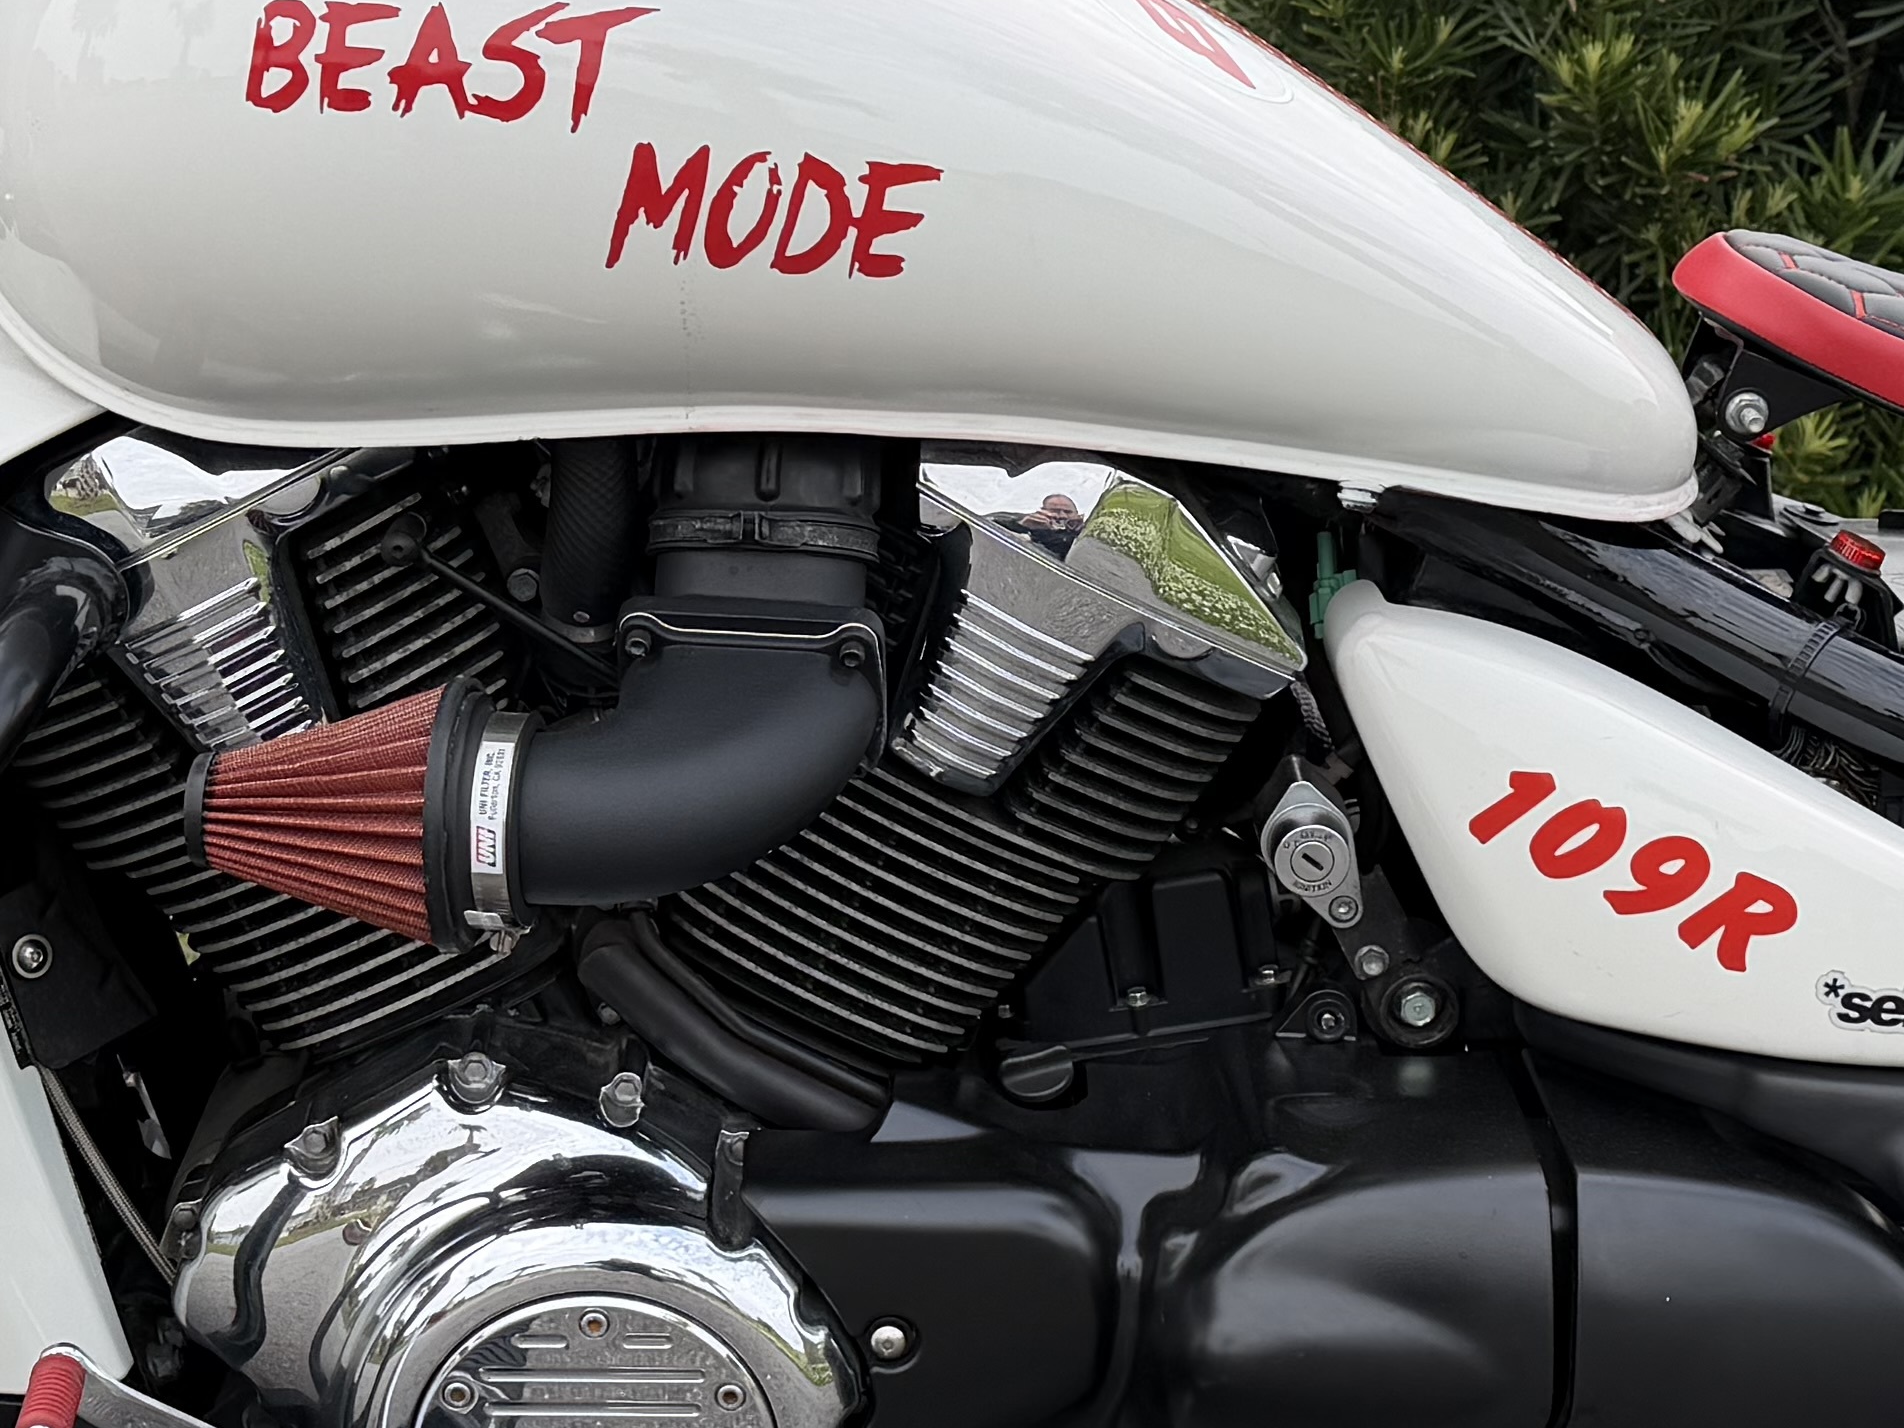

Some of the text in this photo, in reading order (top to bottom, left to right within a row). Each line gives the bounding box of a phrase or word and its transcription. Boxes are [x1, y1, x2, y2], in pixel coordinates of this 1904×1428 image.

[246, 0, 658, 132] BEAST
[606, 143, 944, 278] MODE
[476, 826, 497, 867] UNI
[1469, 771, 1798, 973] 109R
